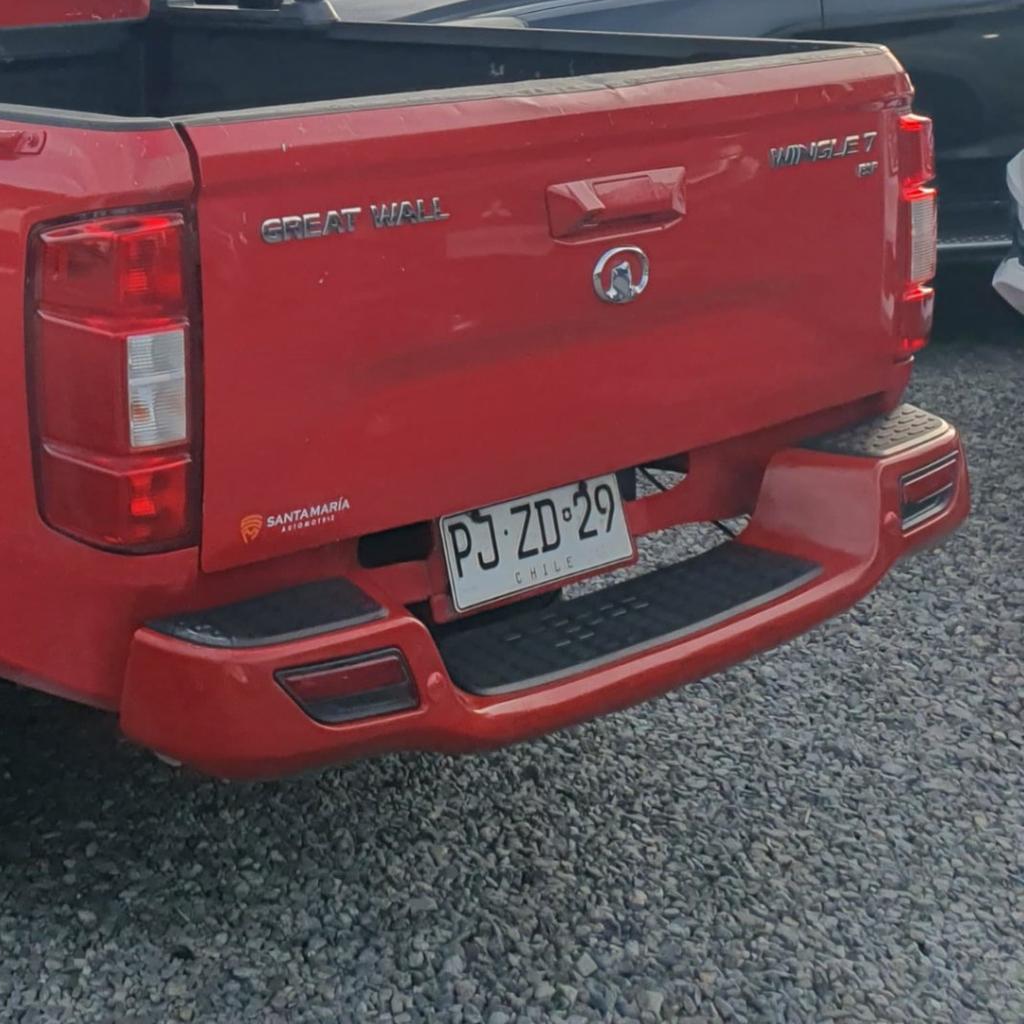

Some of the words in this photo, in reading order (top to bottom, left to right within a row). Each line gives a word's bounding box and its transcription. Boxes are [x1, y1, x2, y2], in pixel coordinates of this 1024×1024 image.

[261, 207, 362, 244] GREAT
[370, 197, 451, 228] WALL
[514, 556, 575, 585] CHILE
